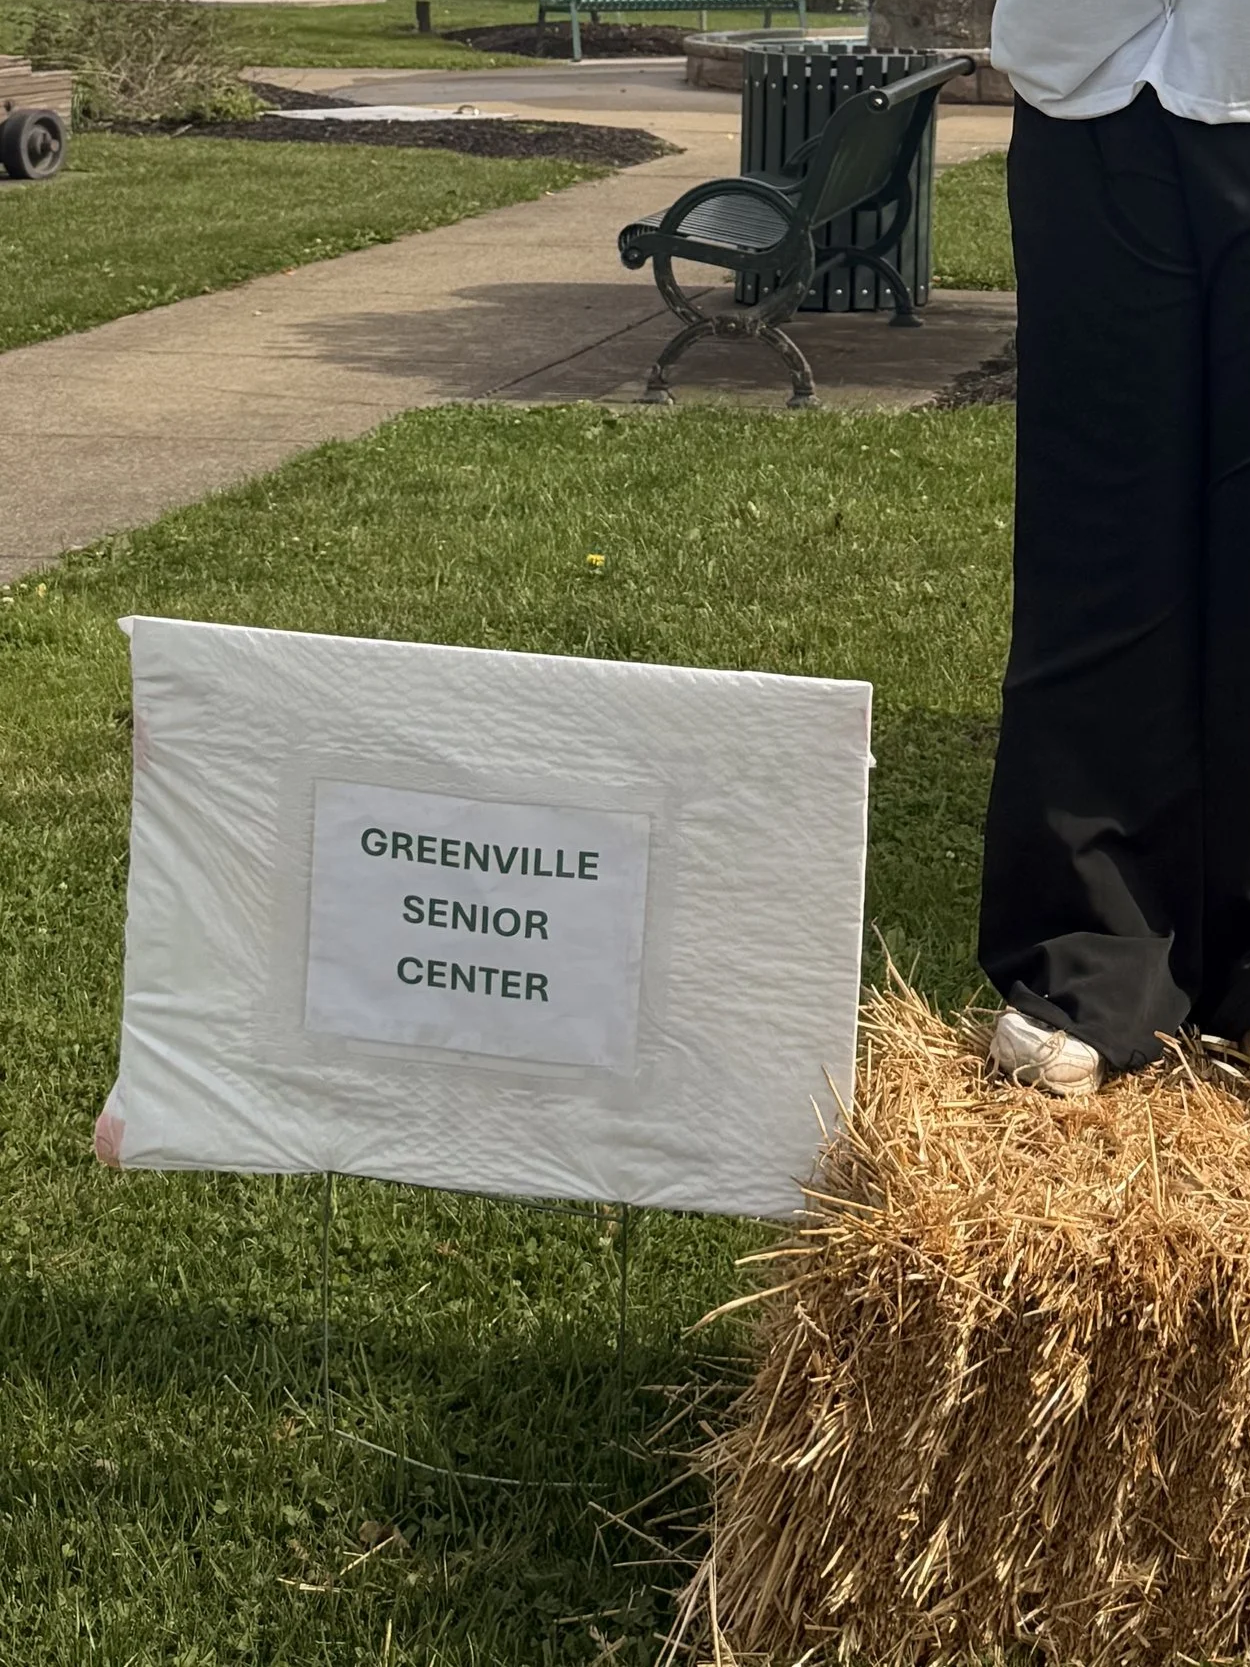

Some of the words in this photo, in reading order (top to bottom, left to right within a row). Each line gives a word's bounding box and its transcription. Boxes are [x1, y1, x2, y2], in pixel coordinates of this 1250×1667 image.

[361, 827, 599, 881] GREENVILLE
[402, 895, 549, 940] SENIOR
[396, 957, 549, 1002] CENTER
